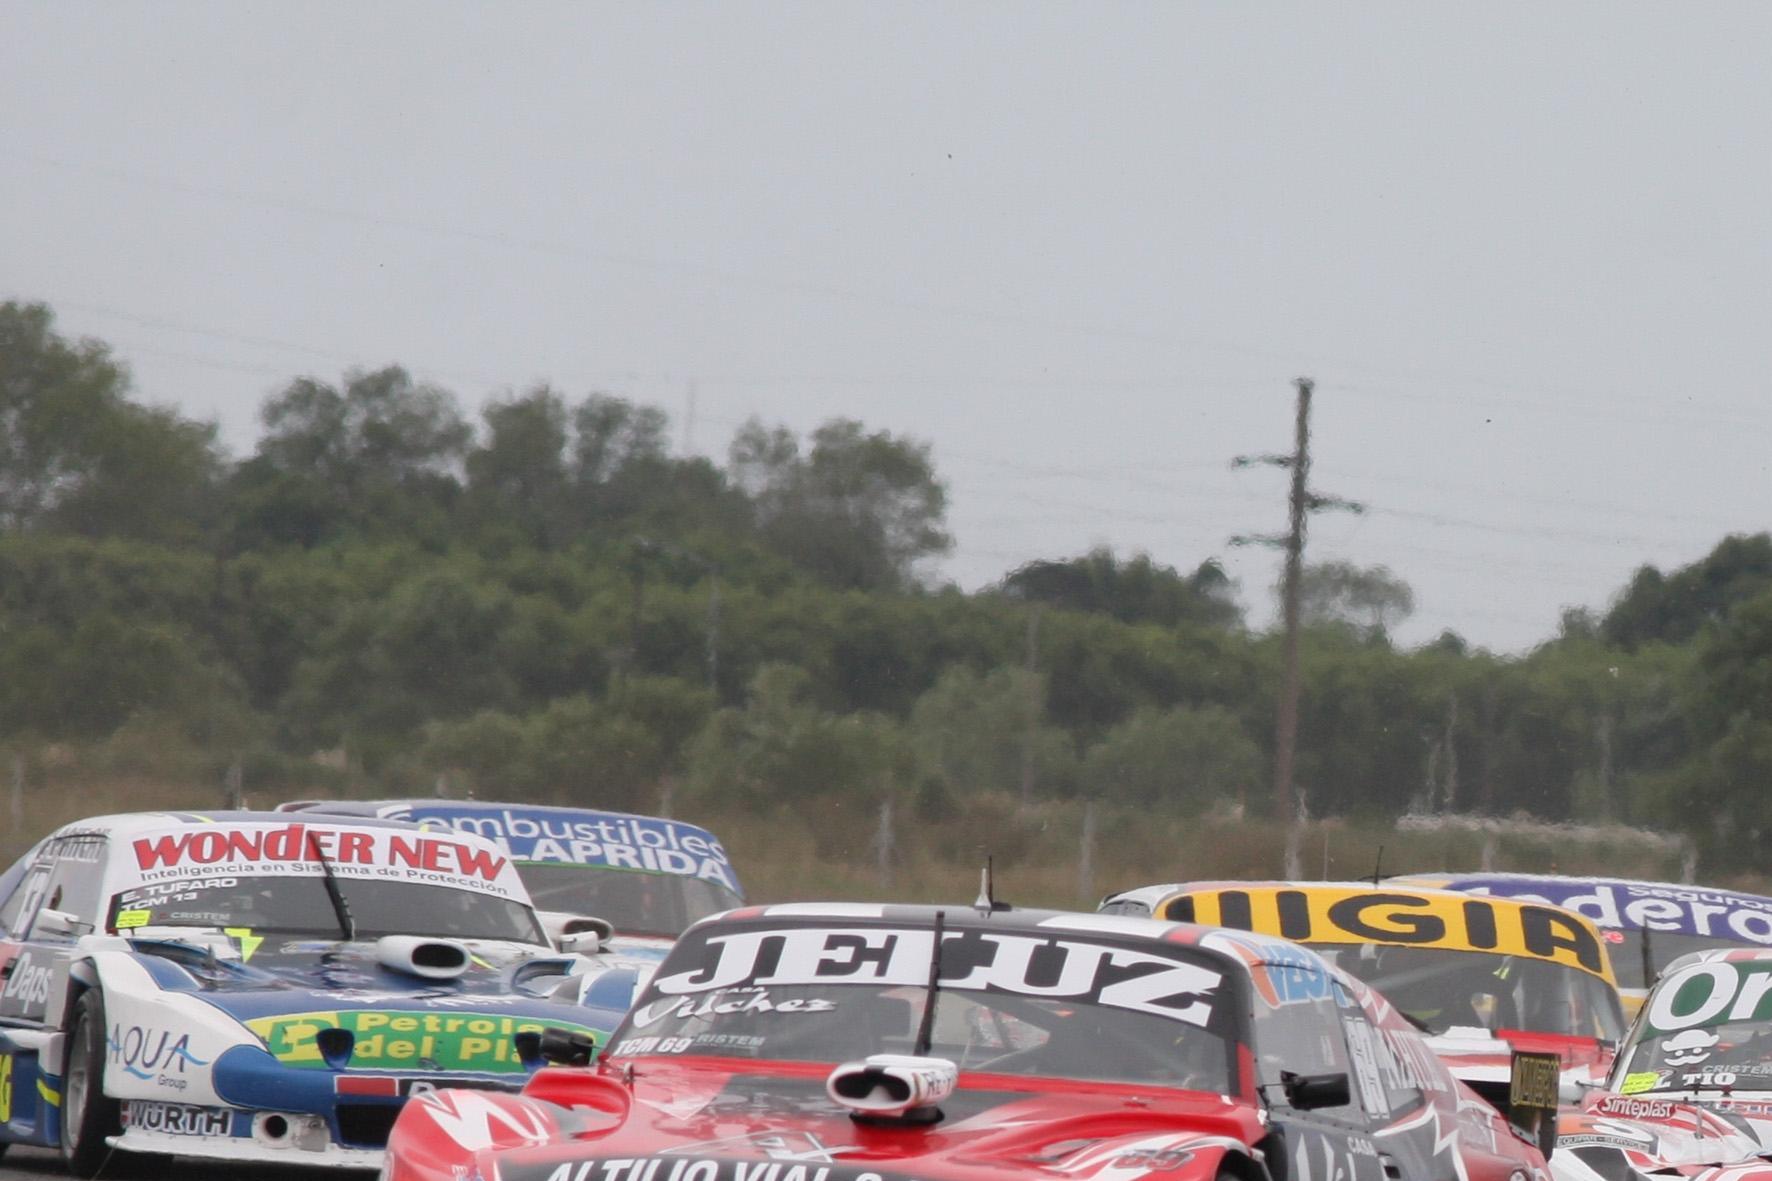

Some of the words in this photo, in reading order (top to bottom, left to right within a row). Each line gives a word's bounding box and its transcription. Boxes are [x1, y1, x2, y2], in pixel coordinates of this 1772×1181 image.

[389, 837, 506, 882] NEW
[494, 836, 734, 892] LAPRIDA
[140, 862, 255, 882] Inteligencia
[261, 863, 285, 873] en
[291, 862, 373, 877] Sisema
[376, 867, 400, 879] de
[406, 870, 509, 896] Protección
[120, 894, 168, 912] TCM
[178, 891, 198, 902] 13
[654, 928, 1222, 1027] JELUZ
[107, 1023, 193, 1074] AQUA
[354, 1034, 434, 1059] del
[612, 1035, 656, 1057] TCM
[657, 1036, 693, 1053] 69
[698, 1034, 767, 1047] RISTEM
[157, 1074, 188, 1089] Group
[1682, 1072, 1737, 1087] TIO
[1600, 1096, 1674, 1119] Sinteplast
